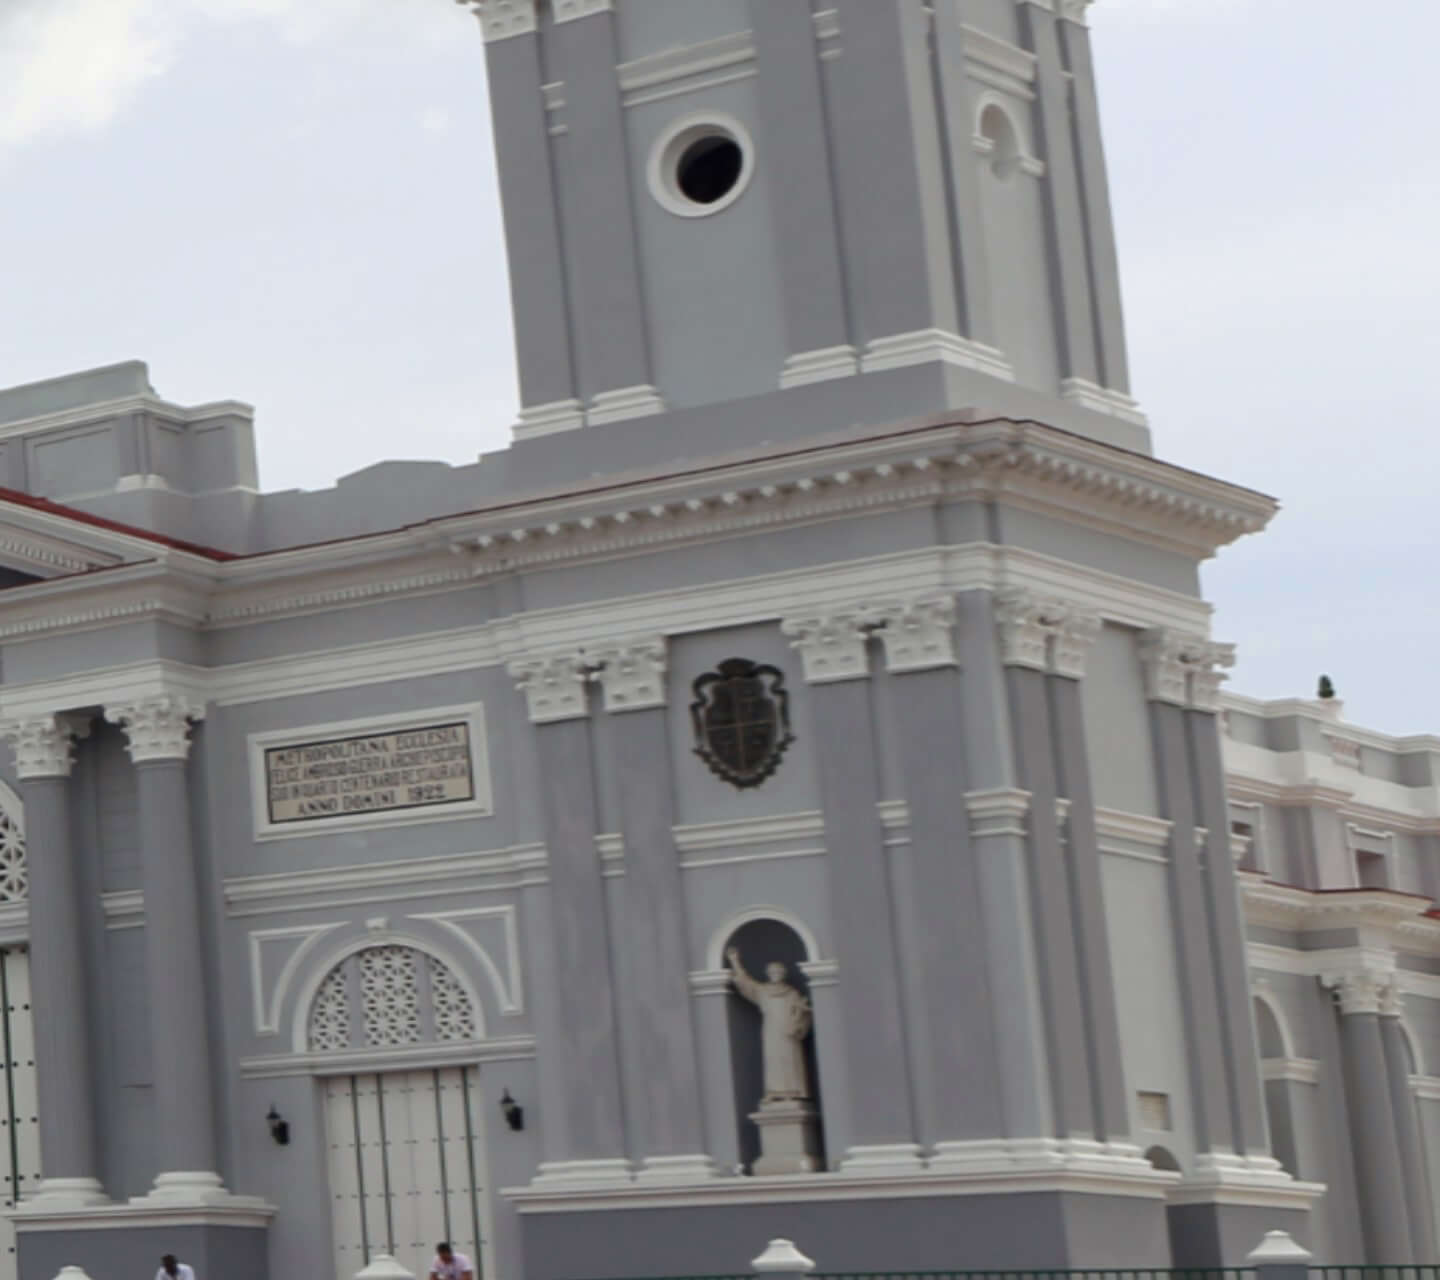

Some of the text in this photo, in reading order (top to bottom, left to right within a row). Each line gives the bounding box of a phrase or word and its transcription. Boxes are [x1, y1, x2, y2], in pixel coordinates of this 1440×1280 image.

[396, 728, 458, 749] ECCLESIA
[298, 798, 337, 814] ANNO
[343, 790, 395, 809] DOMINI
